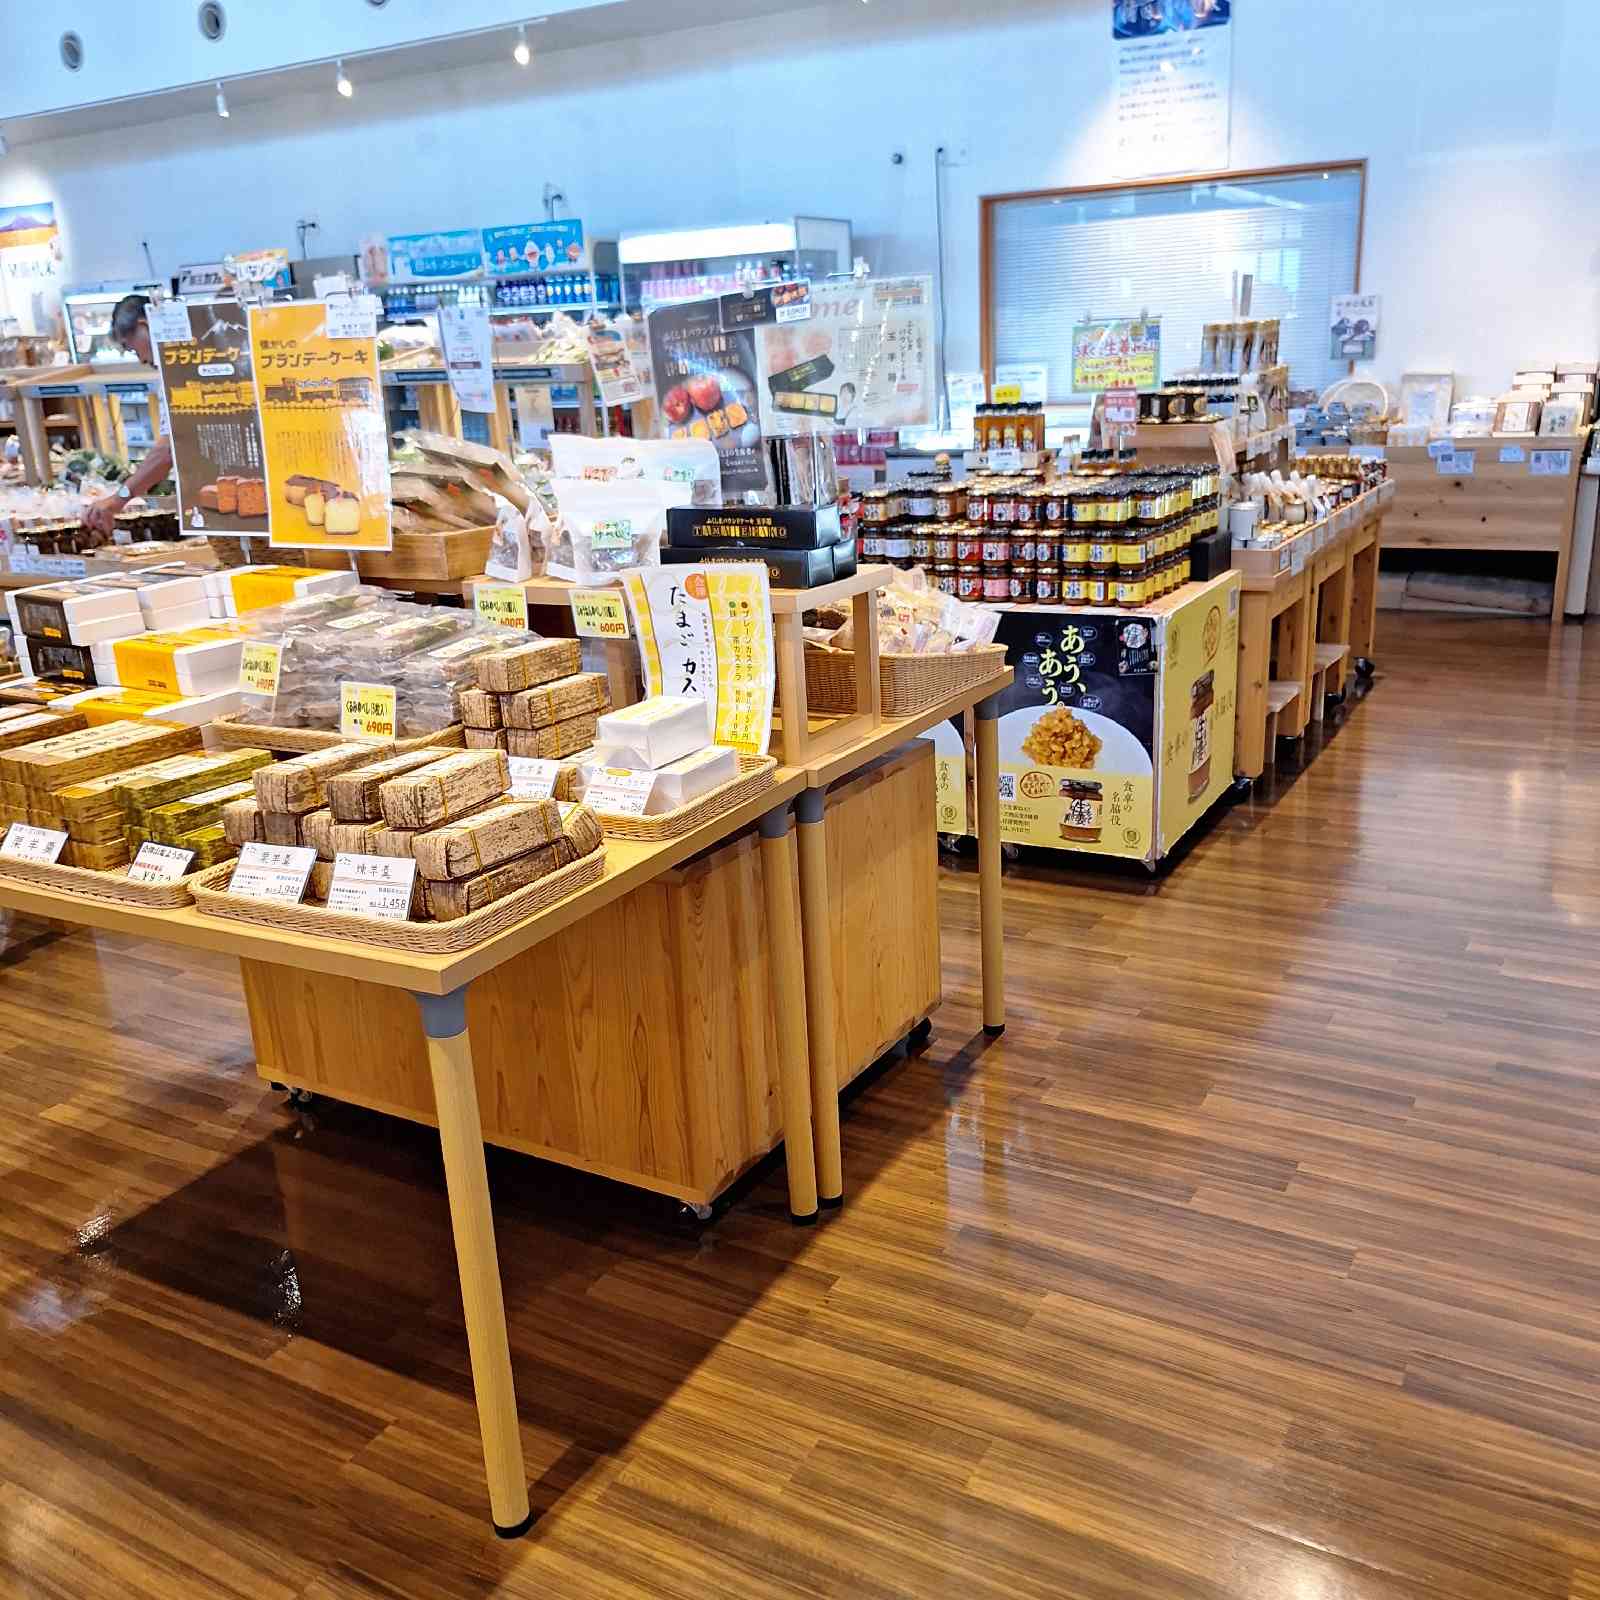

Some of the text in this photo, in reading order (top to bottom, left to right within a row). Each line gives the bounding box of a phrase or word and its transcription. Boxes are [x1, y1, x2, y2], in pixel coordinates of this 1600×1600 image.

[260, 349, 370, 369] ブランデーケーキ
[600, 622, 626, 635] 600円
[366, 720, 393, 736] 690円
